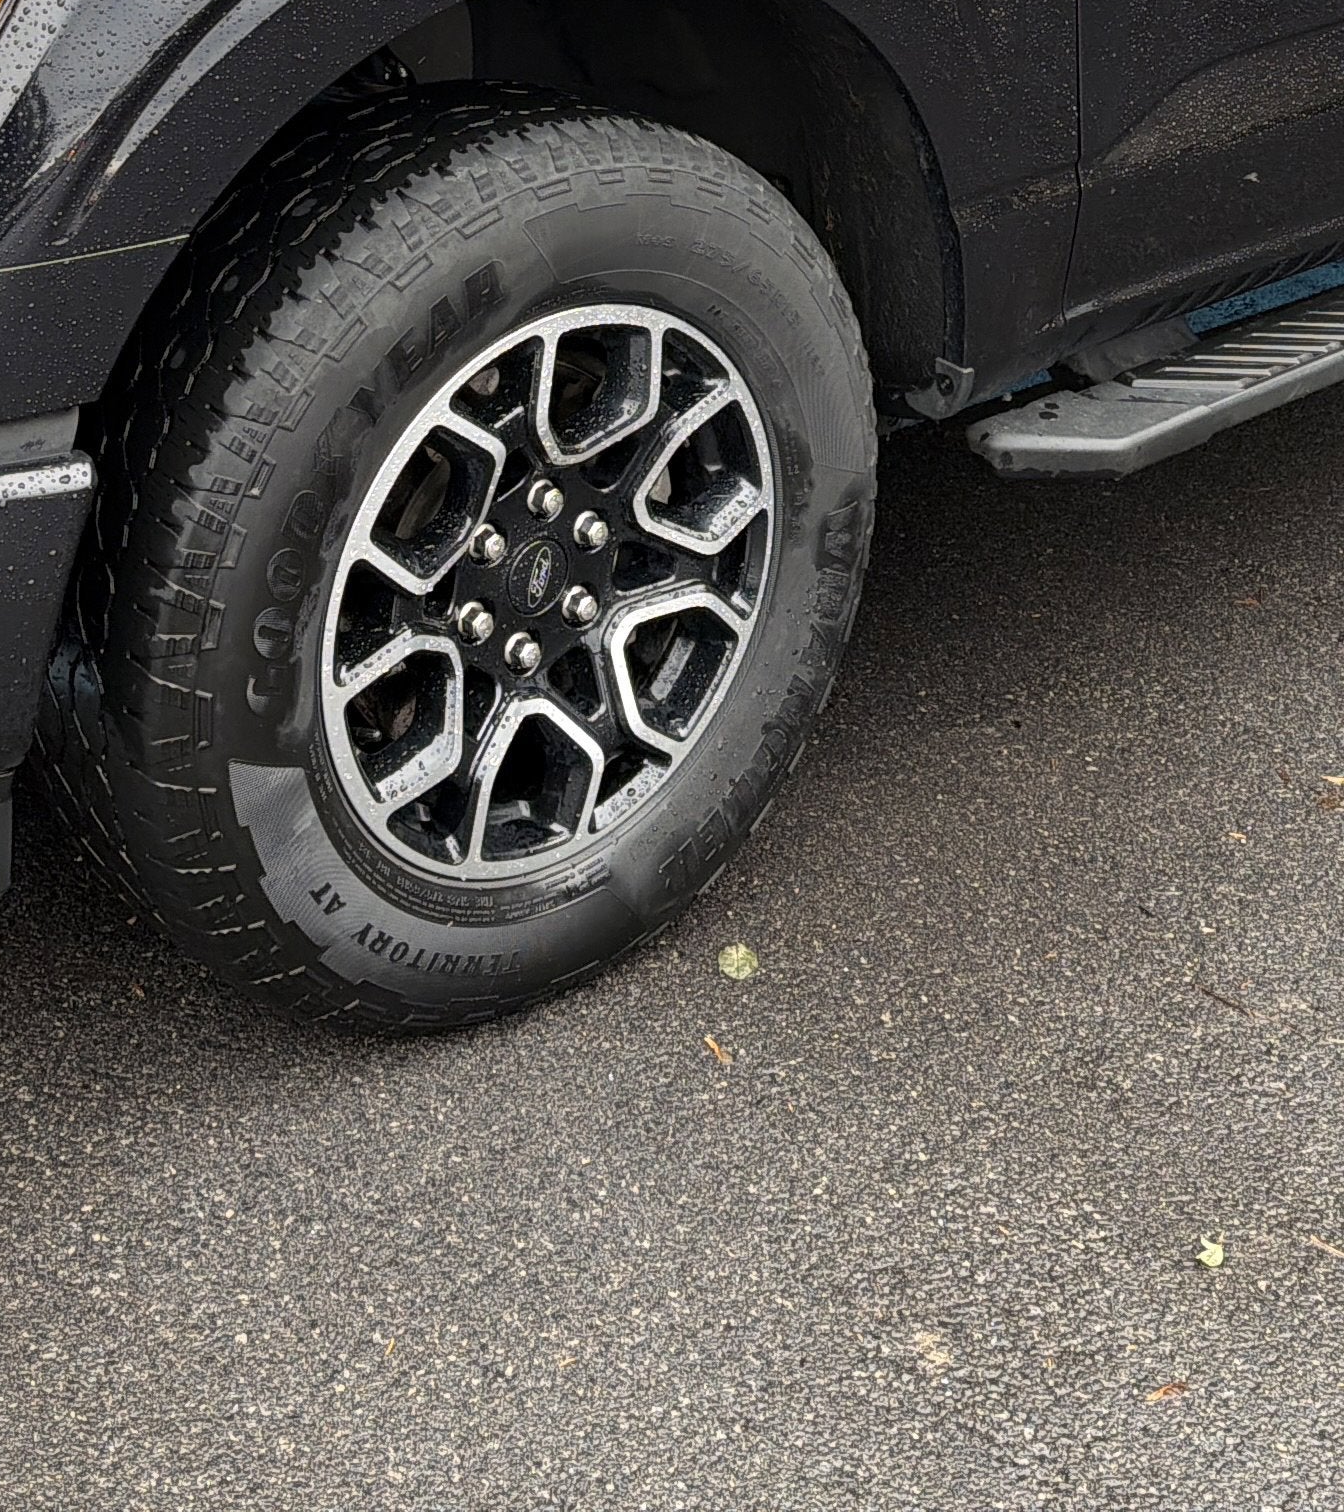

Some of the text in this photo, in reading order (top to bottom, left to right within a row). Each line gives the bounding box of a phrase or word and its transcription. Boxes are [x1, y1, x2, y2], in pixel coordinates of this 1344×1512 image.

[530, 557, 549, 598] Ford
[308, 881, 521, 977] TERRITORY AT
